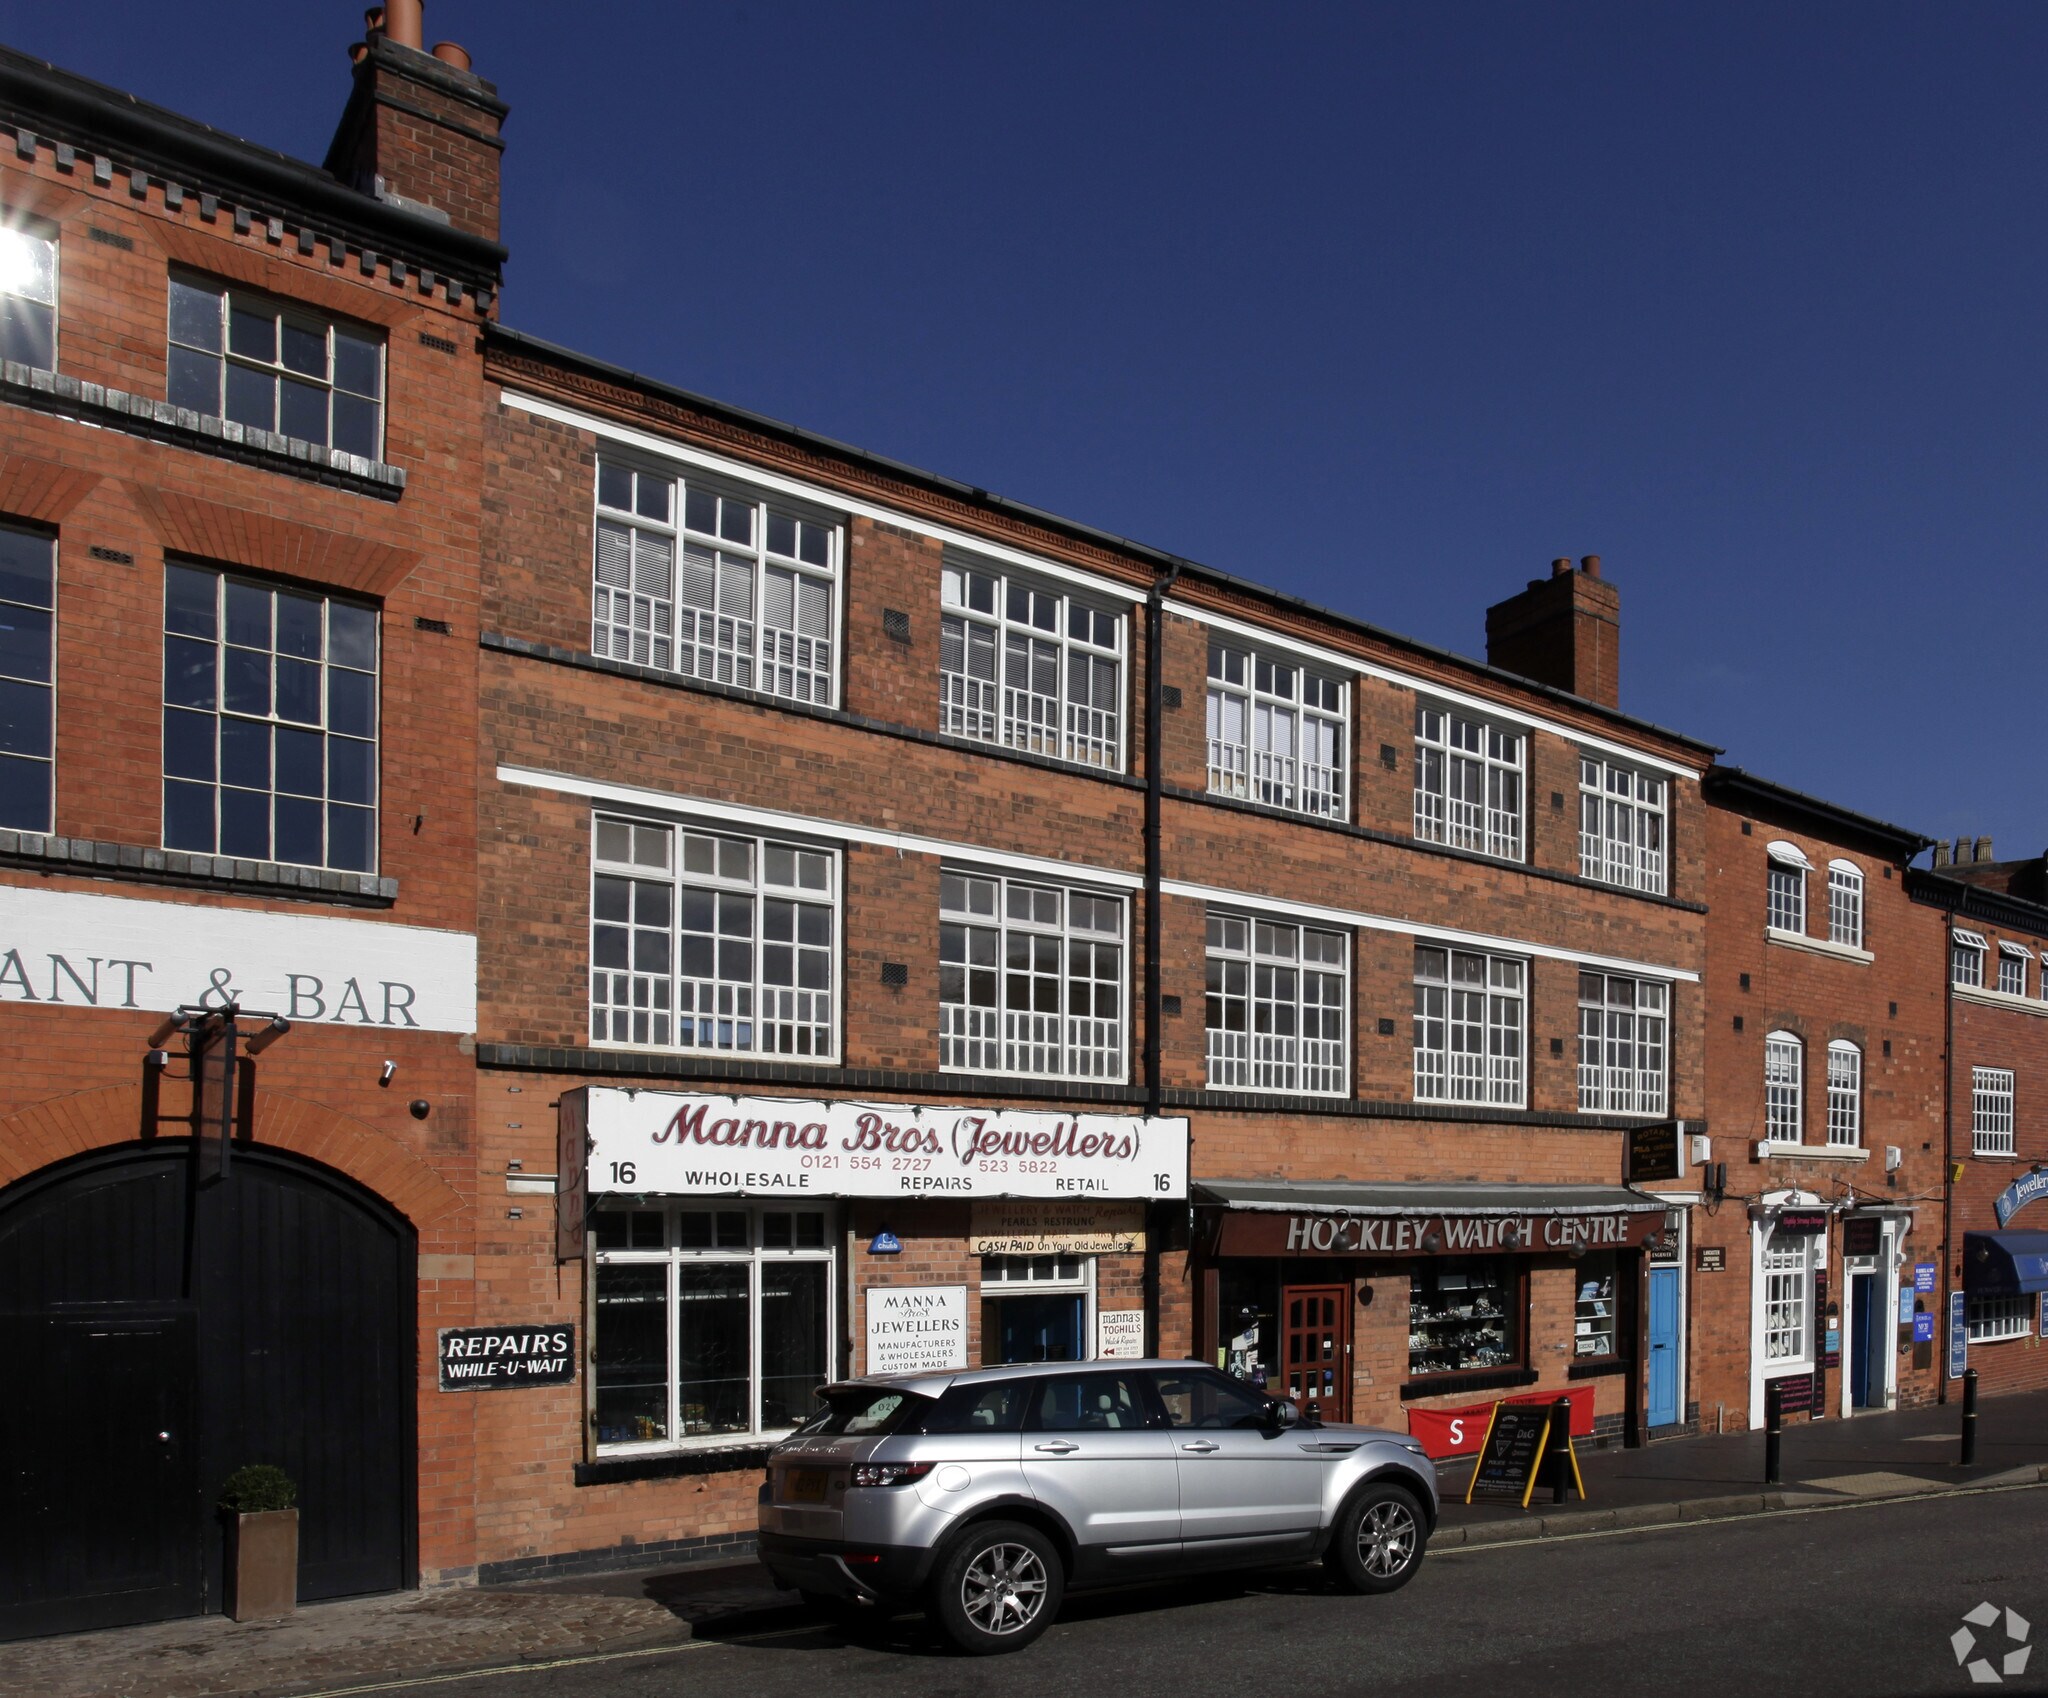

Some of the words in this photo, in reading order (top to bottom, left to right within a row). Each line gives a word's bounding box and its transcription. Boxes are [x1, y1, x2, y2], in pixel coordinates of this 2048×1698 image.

[199, 968, 243, 1010] &
[285, 973, 420, 1027] BAR
[652, 1103, 828, 1149] Manna
[842, 1112, 943, 1154] Bros.
[951, 1116, 1141, 1166] (Jewellers)
[800, 1155, 839, 1169] 0121
[849, 1156, 882, 1170] 554
[892, 1158, 931, 1172] 2727
[979, 1160, 1009, 1173] 523
[1018, 1160, 1058, 1174] 5822
[609, 1161, 637, 1184] 16
[685, 1171, 810, 1188] WHOLESALE
[900, 1176, 973, 1190] REPAIRS
[1056, 1178, 1109, 1191] RETAIL
[1153, 1173, 1171, 1191] 16
[980, 1205, 1039, 1215] JEWELLERY
[1055, 1204, 1091, 1214] WATCH
[1001, 1217, 1038, 1227] PEARLS
[1044, 1216, 1096, 1227] RESTRUNG
[1287, 1218, 1430, 1250] HOCKLEY
[1443, 1218, 1533, 1248] WATCH
[1544, 1216, 1629, 1246] CENTRE
[978, 1240, 1008, 1252] CASH
[1010, 1240, 1034, 1252] PAID
[1037, 1241, 1050, 1251] On
[1052, 1241, 1073, 1251] Your
[1074, 1240, 1089, 1251] Old
[884, 1294, 947, 1309] MANNA
[1102, 1313, 1141, 1324] manna's
[871, 1318, 960, 1335] JEWELLERS
[446, 1333, 568, 1358] REPAIRS
[877, 1339, 956, 1351] MANUFACTURERS
[879, 1353, 886, 1361] &
[881, 1362, 918, 1371] CUSTOM
[922, 1360, 948, 1369] MADE
